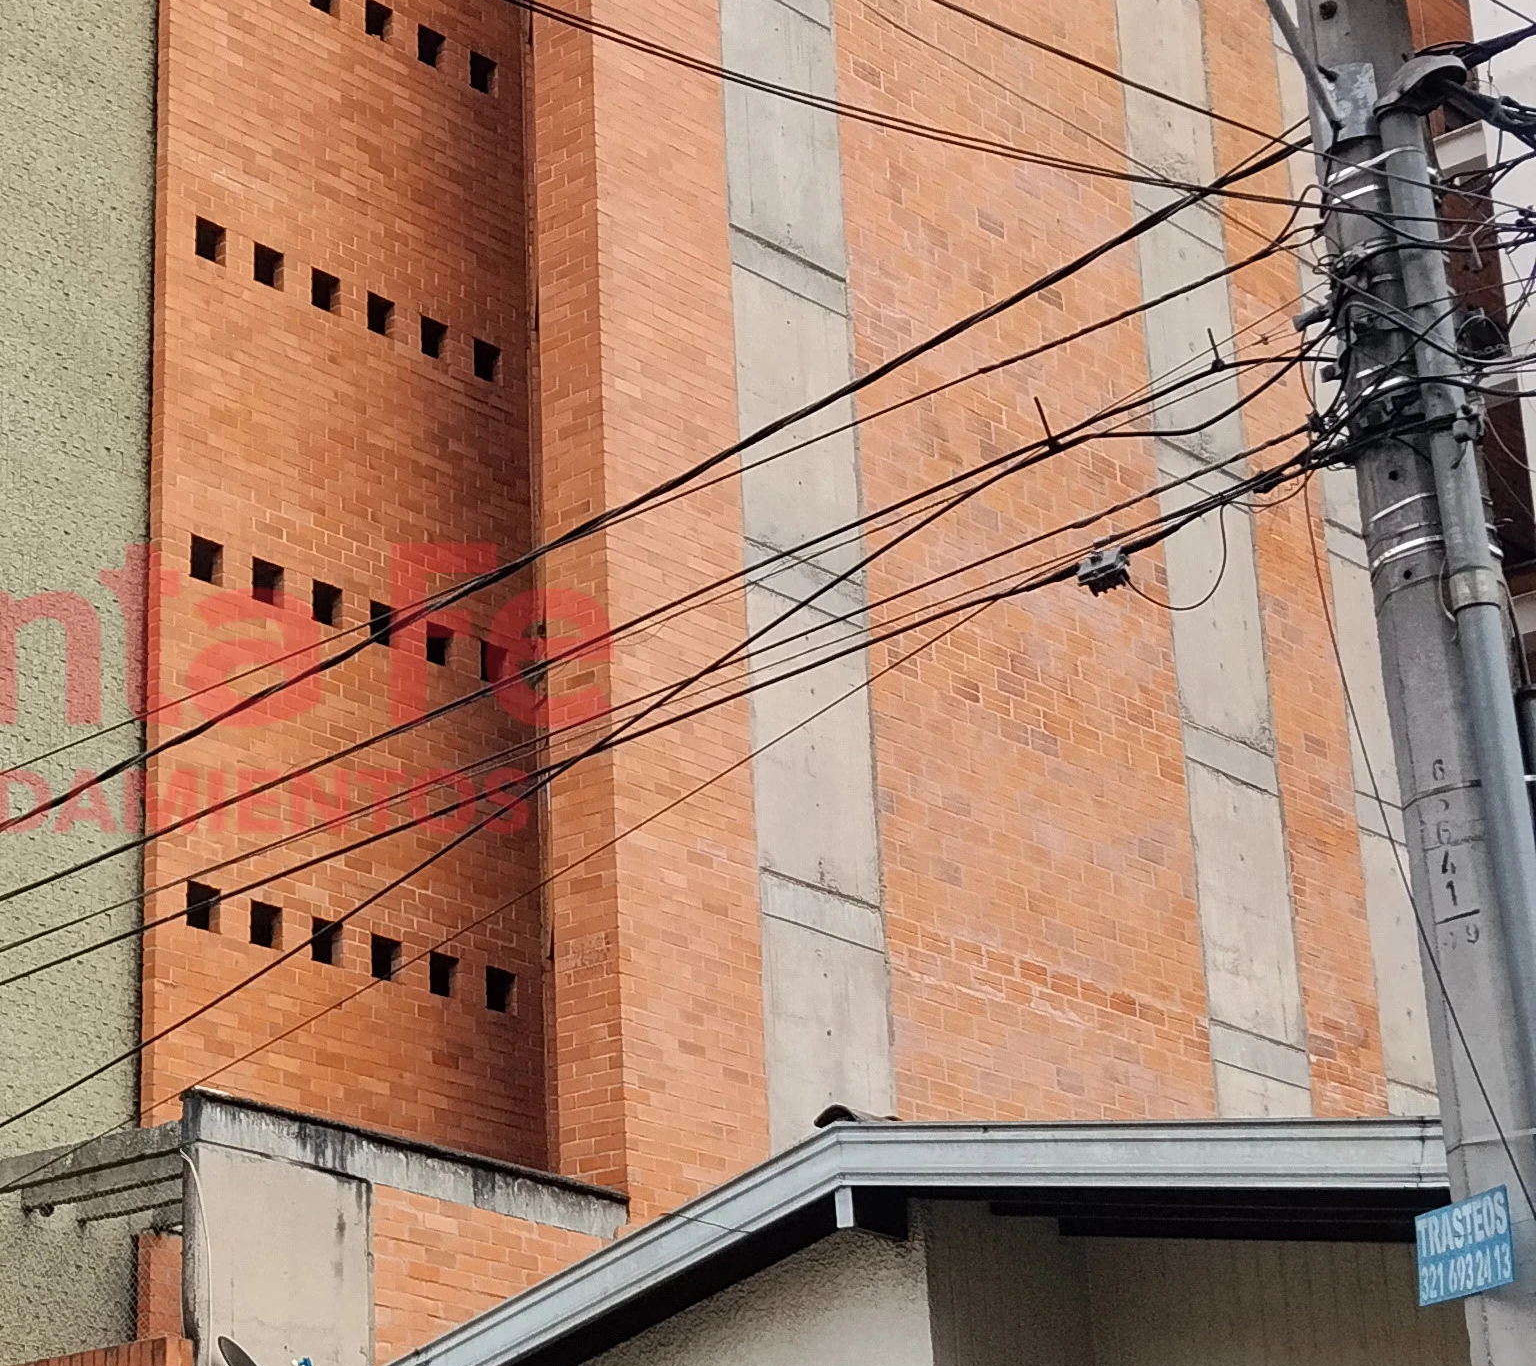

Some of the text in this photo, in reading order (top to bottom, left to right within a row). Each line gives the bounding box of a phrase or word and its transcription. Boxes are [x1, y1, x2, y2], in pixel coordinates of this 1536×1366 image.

[1417, 1192, 1508, 1257] TRASTEOS
[1420, 1263, 1444, 1301] 321
[1449, 1253, 1474, 1293] 693
[1494, 1243, 1511, 1280] 13
